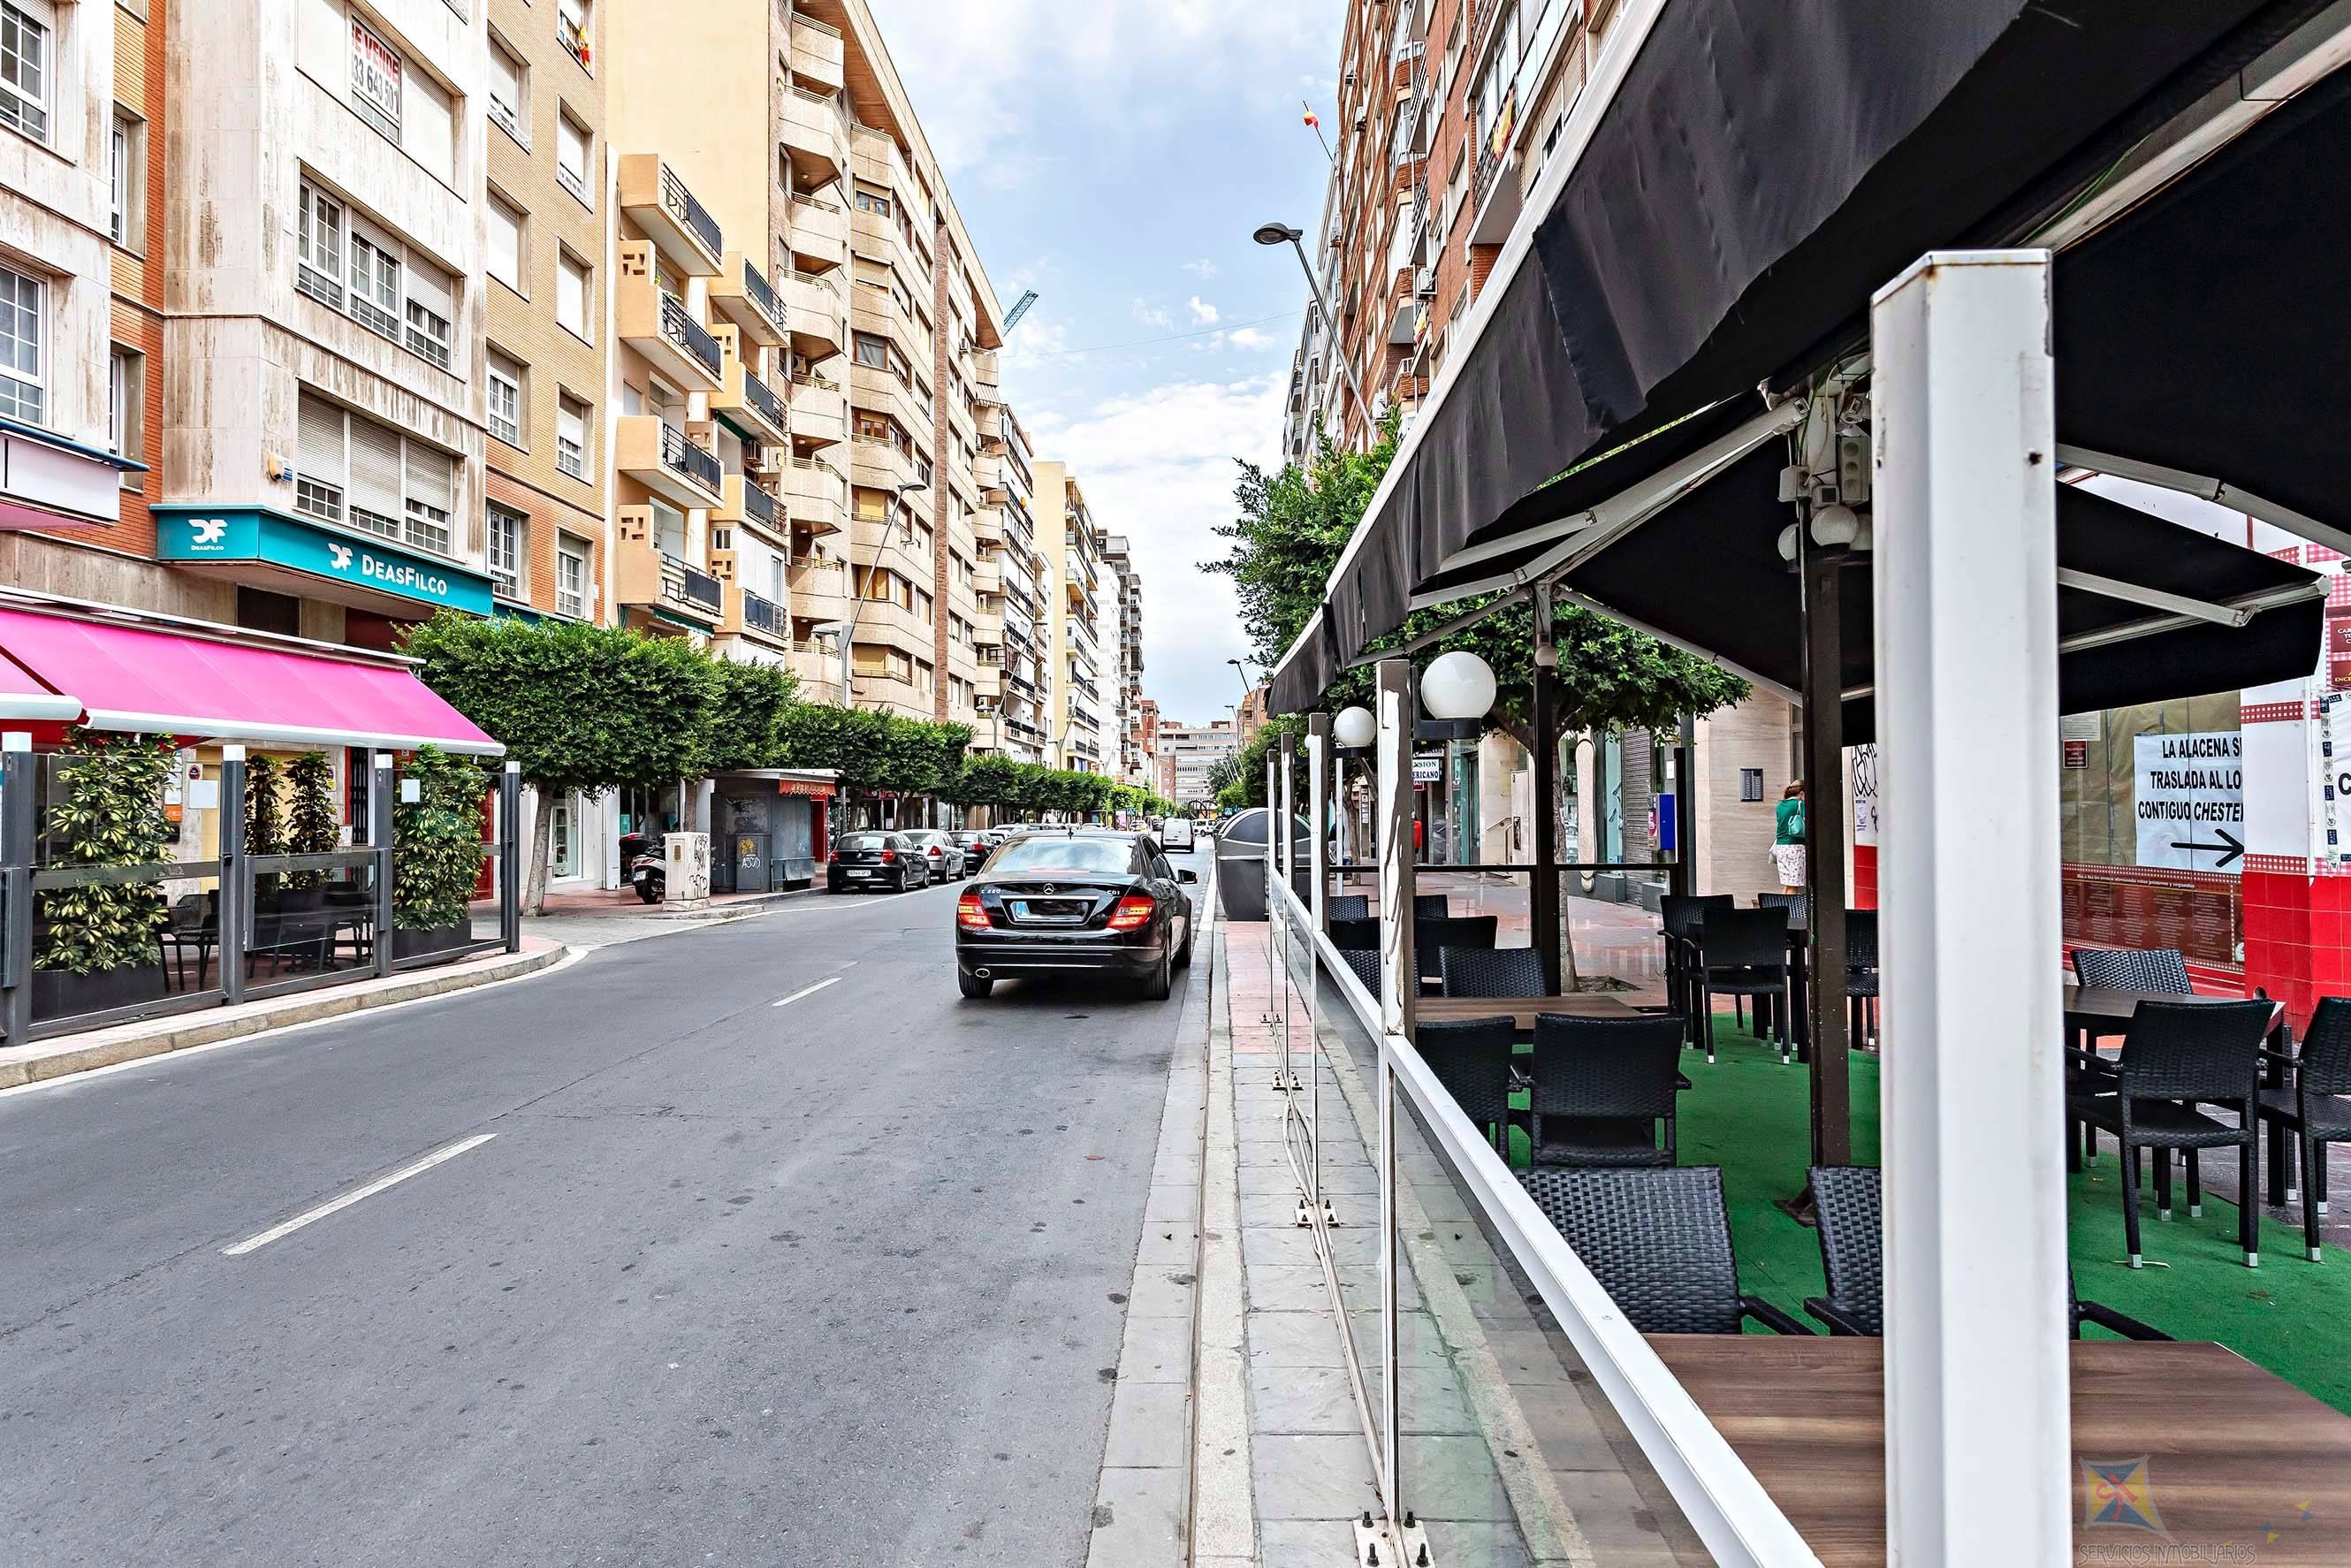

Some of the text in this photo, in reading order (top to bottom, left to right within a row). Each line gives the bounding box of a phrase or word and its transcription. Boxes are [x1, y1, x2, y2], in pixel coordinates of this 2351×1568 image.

[364, 33, 399, 87] VENDE
[367, 65, 383, 102] 643
[2162, 741, 2176, 758] LA
[2179, 738, 2230, 758] ALACENA
[2150, 770, 2207, 789] TRASLADA
[2210, 770, 2223, 789] AL
[2139, 801, 2191, 820] CONTIGUO
